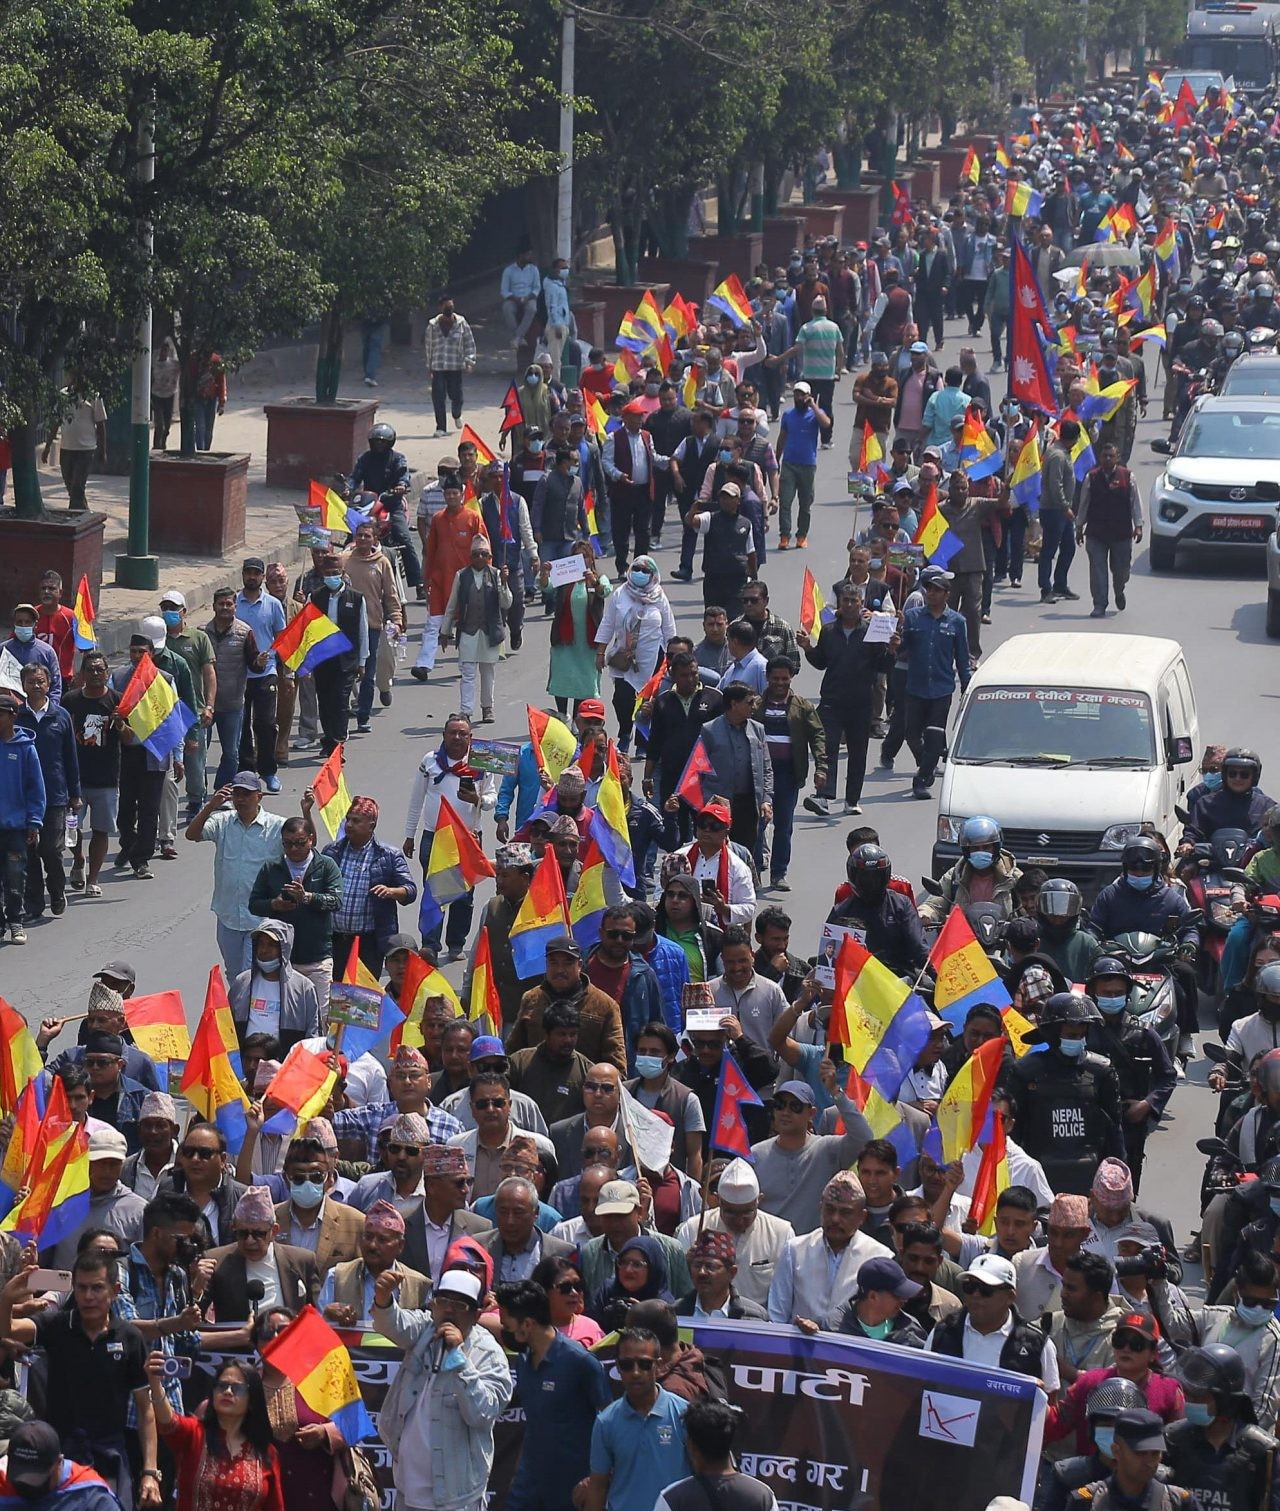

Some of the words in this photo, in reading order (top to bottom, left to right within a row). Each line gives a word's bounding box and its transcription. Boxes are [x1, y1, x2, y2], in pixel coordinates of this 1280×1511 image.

[1052, 1108, 1084, 1122] NEPAL
[1053, 1123, 1085, 1138] POLICE
[730, 1364, 871, 1406] पार्टी
[739, 1452, 799, 1483] बन्द
[806, 1459, 848, 1491] गर
